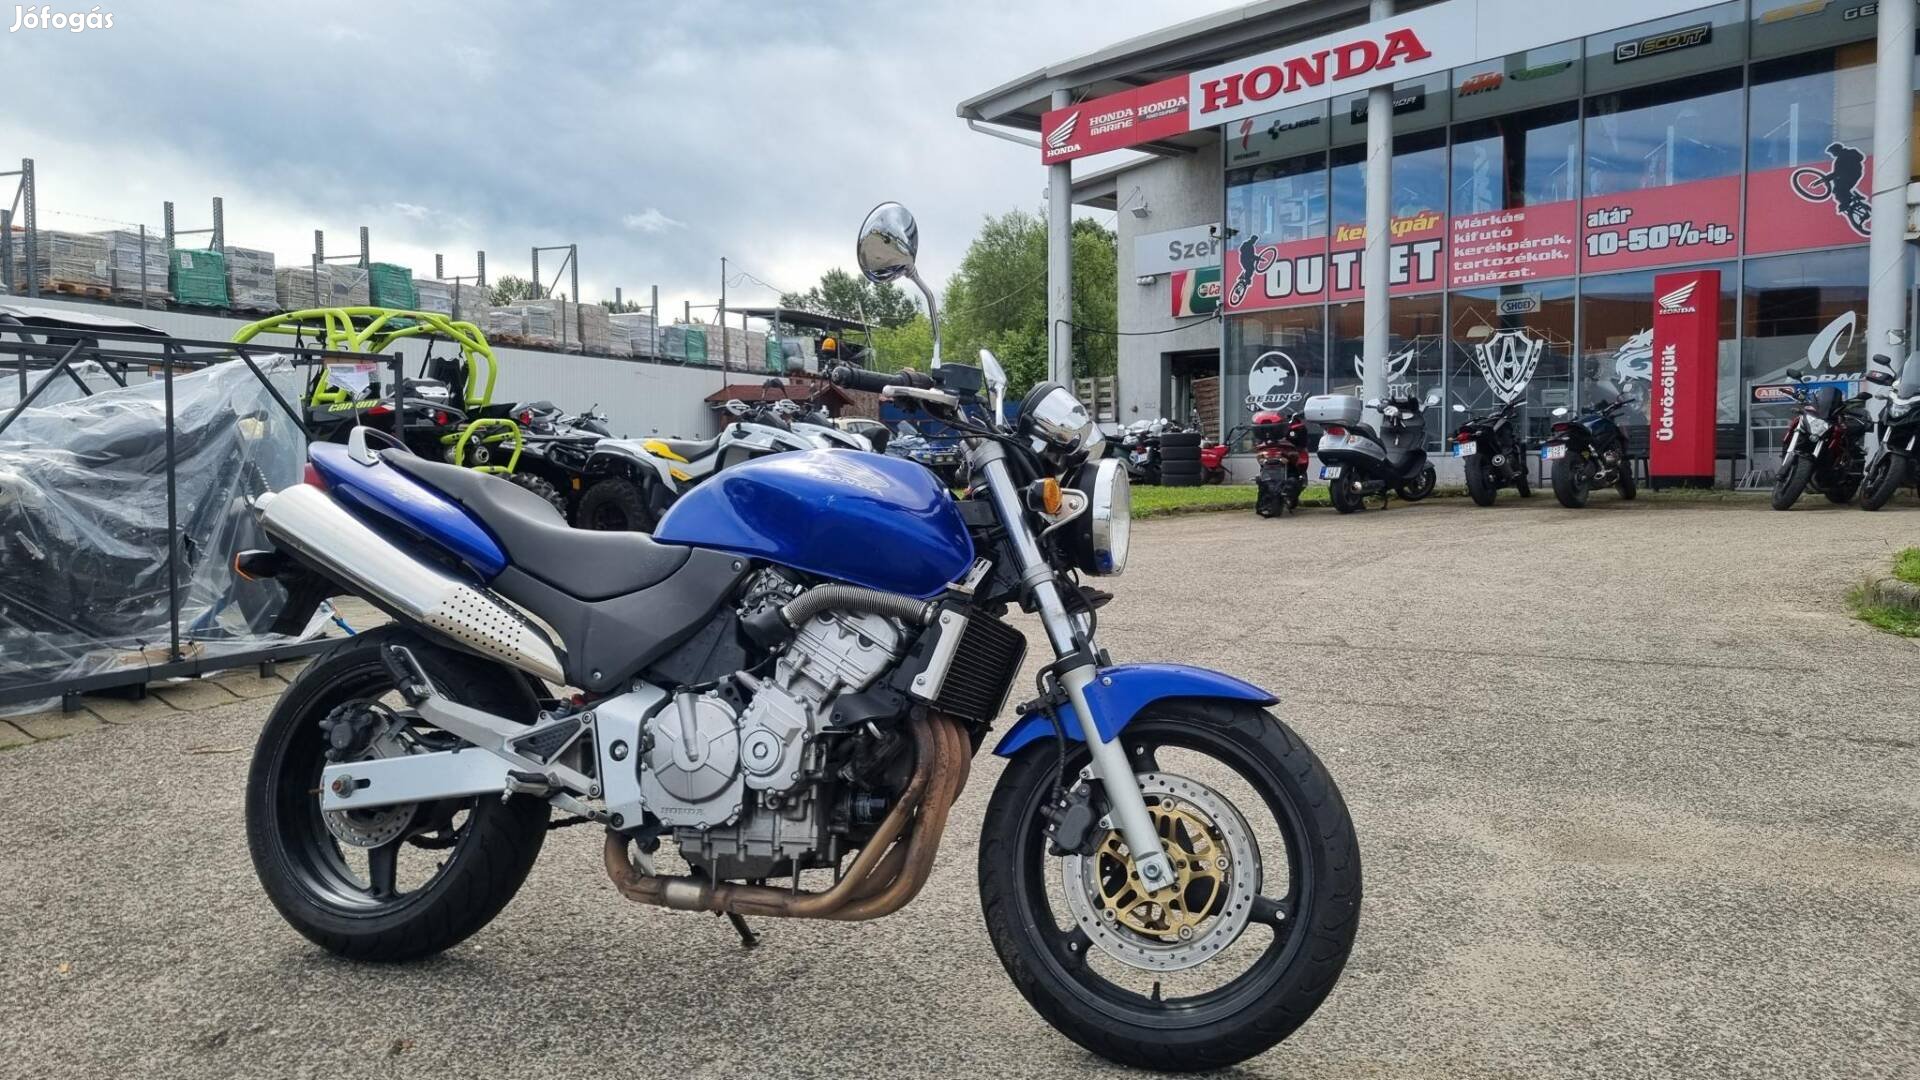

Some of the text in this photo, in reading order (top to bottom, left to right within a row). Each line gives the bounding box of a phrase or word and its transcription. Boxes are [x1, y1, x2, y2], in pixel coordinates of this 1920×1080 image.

[1844, 3, 1879, 20] GE
[1642, 28, 1707, 51] SCOTT
[1200, 28, 1432, 114] HONDA
[1137, 96, 1188, 116] HONDA
[1089, 108, 1134, 127] HONDA
[1278, 117, 1321, 132] CUBE
[1047, 144, 1082, 157] HONDA
[1454, 212, 1525, 230] Márkás
[1587, 206, 1632, 228] akár
[1454, 227, 1513, 244] kifutó
[1586, 221, 1734, 257] 10-50%-ig.
[1454, 234, 1571, 257] kerékpárok,
[1453, 249, 1569, 271] tartozékok,
[1453, 267, 1536, 284] ruházat.
[1506, 302, 1531, 312] SHOEI
[1659, 306, 1696, 315] HONDA
[1656, 343, 1678, 441] Üdvözöljük
